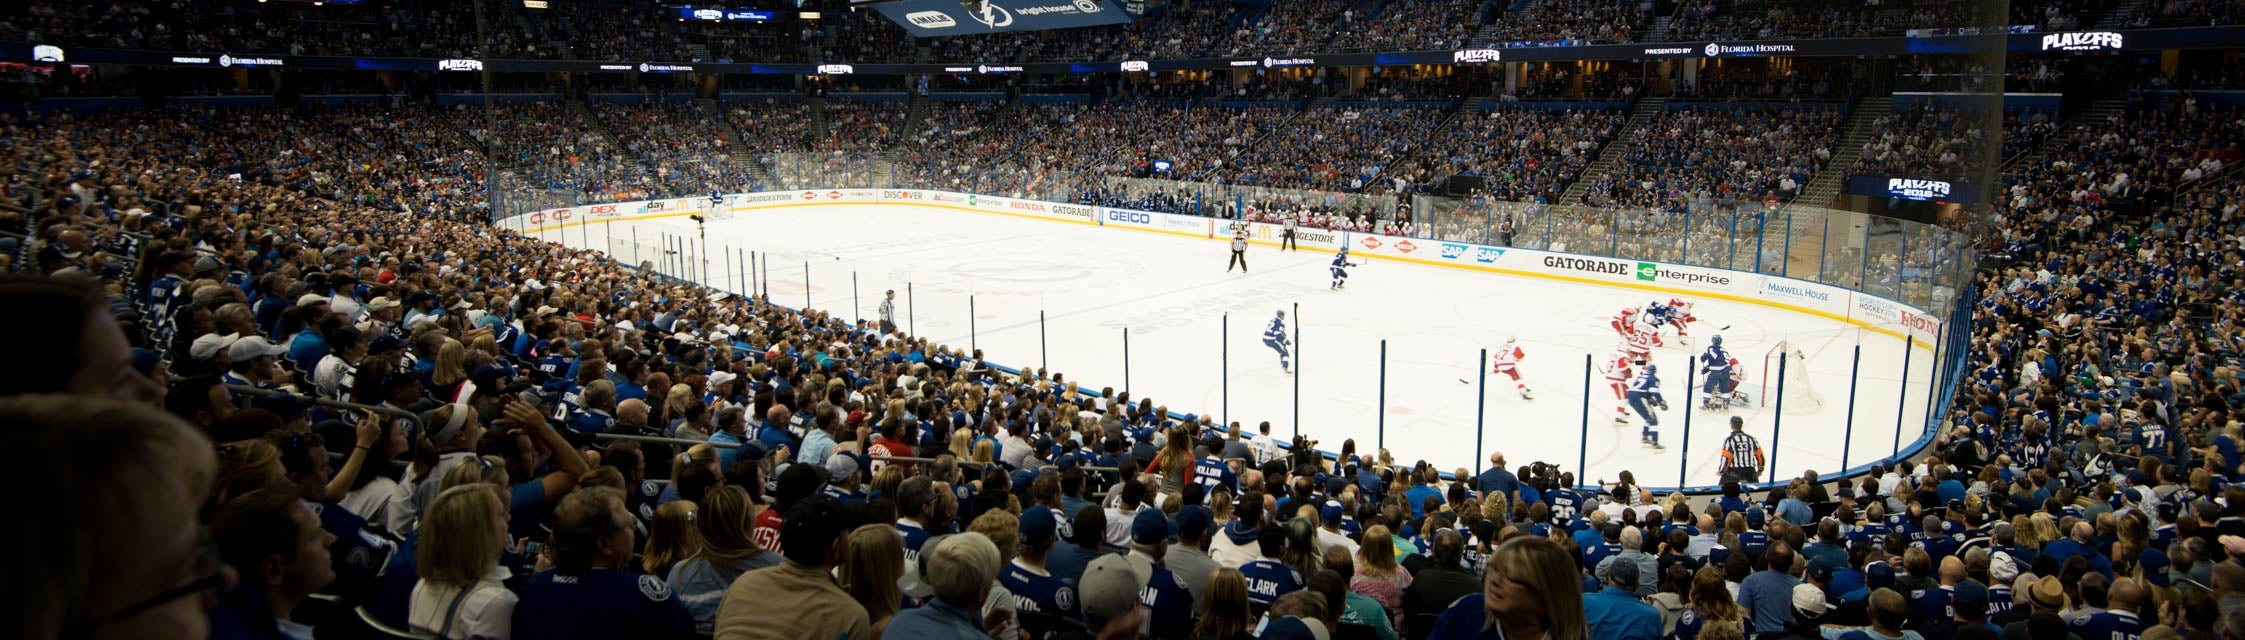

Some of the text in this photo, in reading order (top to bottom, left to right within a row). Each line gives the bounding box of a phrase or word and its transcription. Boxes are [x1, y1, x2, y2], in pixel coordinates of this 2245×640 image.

[1016, 6, 1045, 16] bright
[1046, 5, 1076, 13] house
[912, 14, 951, 25] AMALIE
[2042, 32, 2122, 50] PLAYOFFS
[1454, 50, 1500, 62] PLAYOFFS
[439, 60, 482, 70] PLAYOFFS
[1889, 178, 1950, 194] PLAYOFFS
[746, 194, 793, 202] BRIDGESTONE
[884, 190, 923, 200] DISCOVER
[1903, 188, 1934, 198] 2016
[590, 205, 617, 214] DEX
[637, 204, 648, 214] all
[647, 200, 664, 210] day
[1010, 201, 1046, 211] HONDA
[1052, 206, 1091, 217] GATORADE
[1109, 210, 1150, 224] GEICO
[1229, 221, 1248, 231] da
[1442, 244, 1464, 256] SAP
[1478, 248, 1500, 260] SAP
[1543, 256, 1628, 275] GATORADE
[1639, 264, 1730, 285] enterprise
[1768, 282, 1803, 296] MAXWELL
[1805, 288, 1829, 301] HOUSE
[1860, 303, 1883, 314] HOCKEY
[1632, 330, 1650, 345] 65
[2142, 430, 2165, 449] 77
[1736, 442, 1749, 450] 33
[1245, 577, 1278, 597] CLARK
